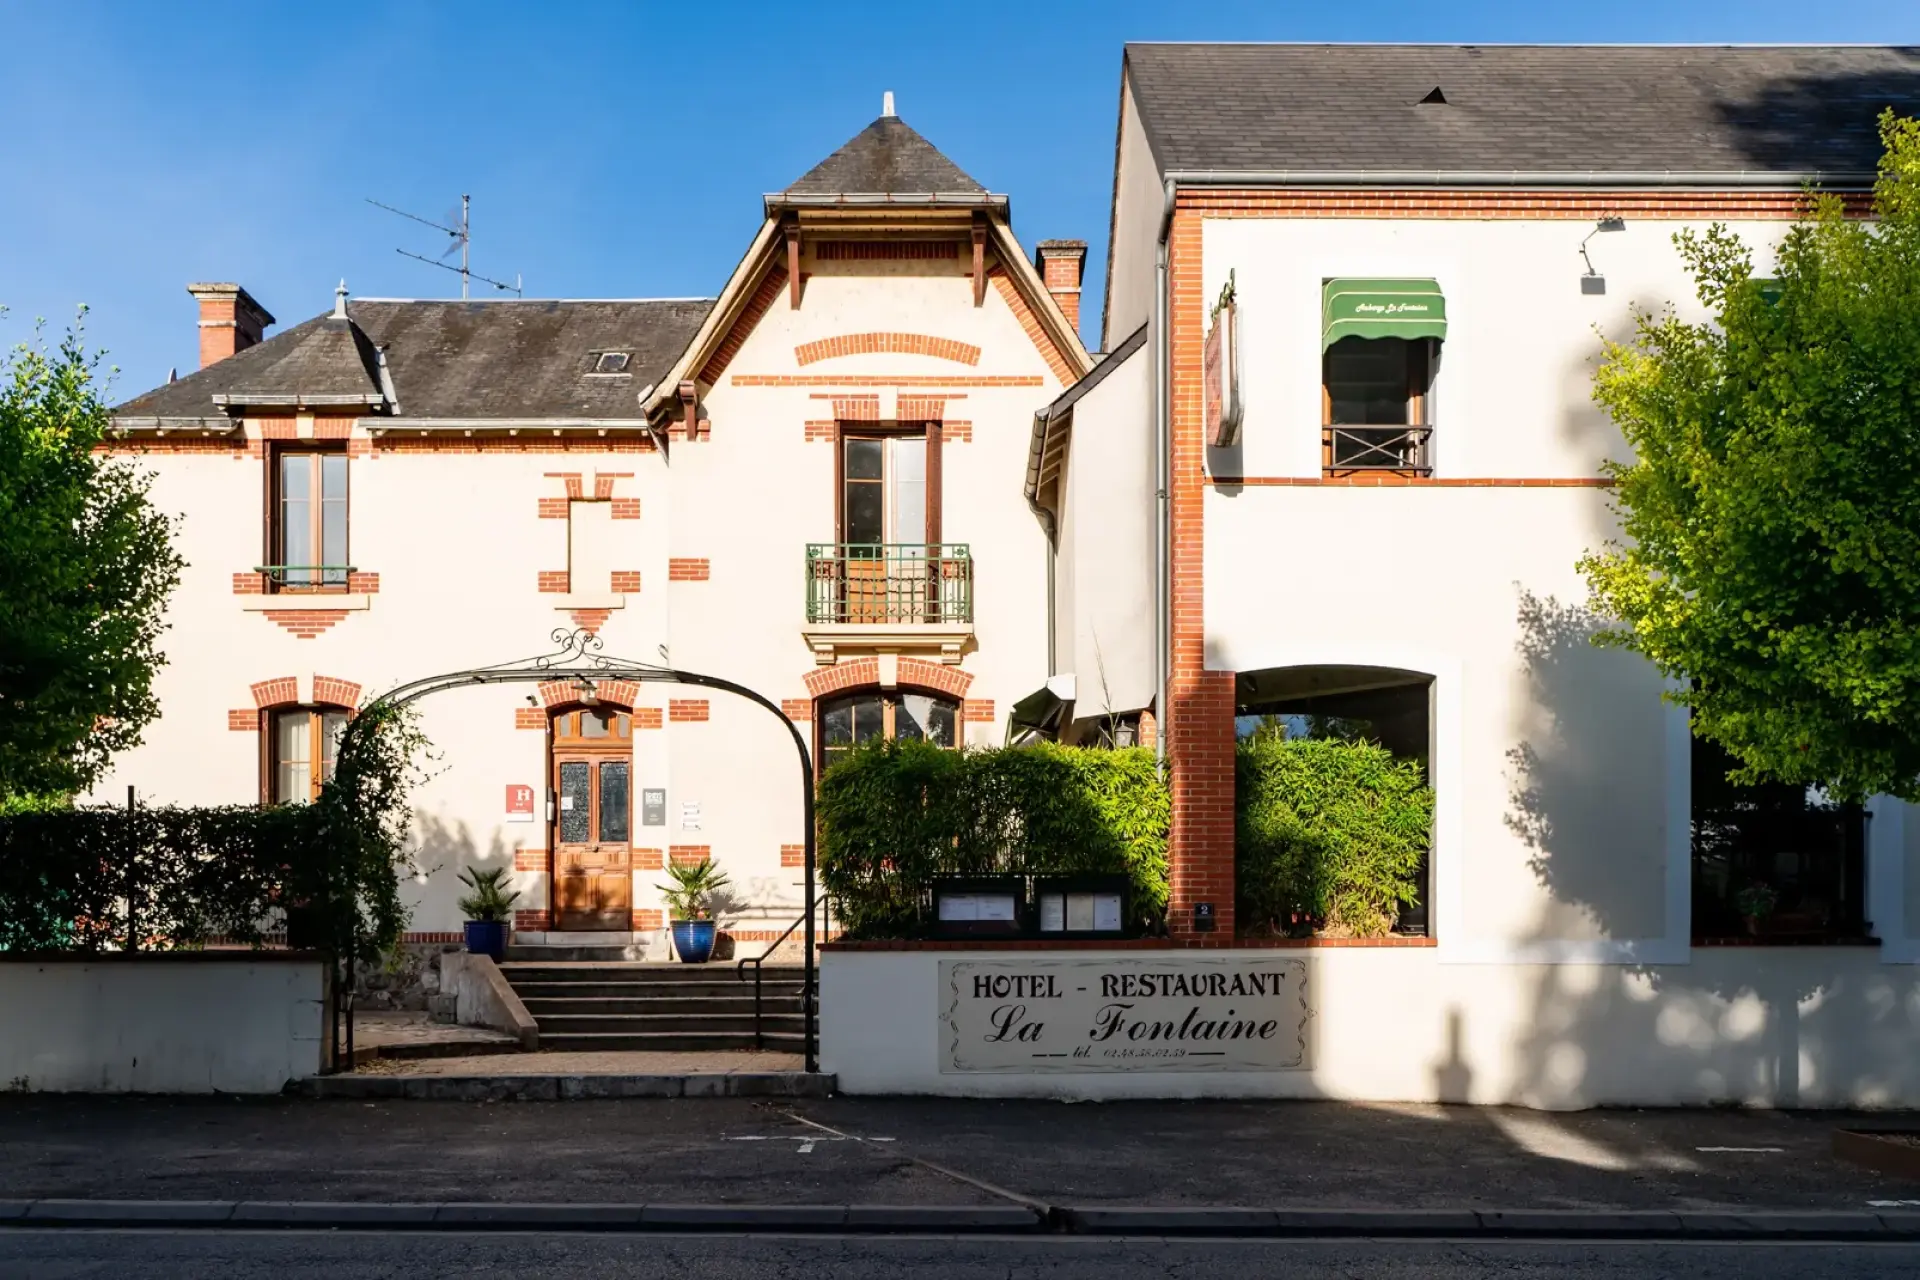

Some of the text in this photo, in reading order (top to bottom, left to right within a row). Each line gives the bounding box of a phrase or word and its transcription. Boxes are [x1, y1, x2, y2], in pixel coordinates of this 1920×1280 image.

[1200, 904, 1208, 915] 2
[972, 974, 1063, 999] HOTEL
[1100, 972, 1286, 998] RESTAURANT
[983, 1003, 1278, 1043] La Fontaine
